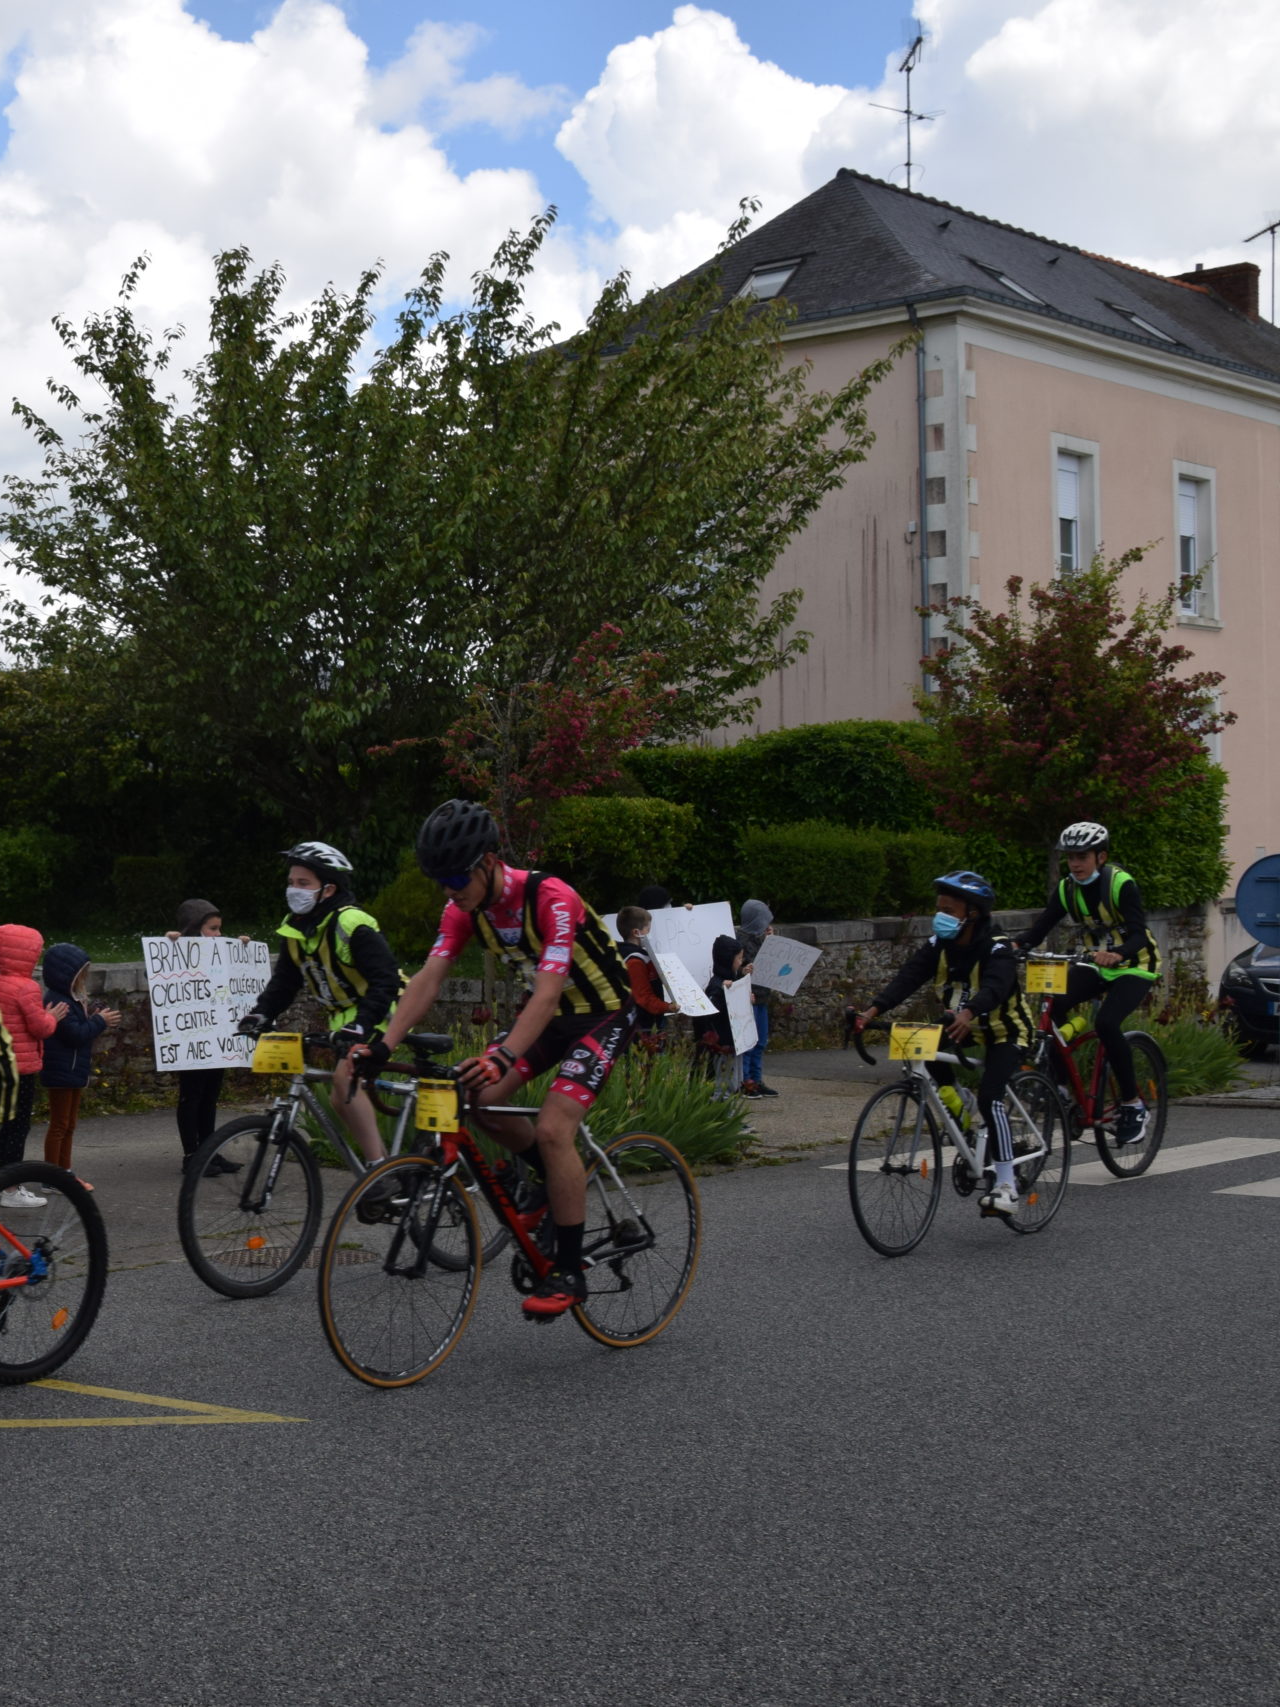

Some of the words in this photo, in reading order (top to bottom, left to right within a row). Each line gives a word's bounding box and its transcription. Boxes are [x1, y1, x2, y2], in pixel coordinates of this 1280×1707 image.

[148, 941, 201, 974] BRAVO
[226, 941, 250, 964] TOUS
[254, 942, 268, 965] LES
[155, 1015, 171, 1035] LE
[175, 1009, 219, 1031] CENTRE
[160, 1043, 181, 1064] EST
[186, 1040, 213, 1061] AVEC
[217, 1036, 243, 1054] VOUS
[586, 1027, 622, 1090] MONBANA
